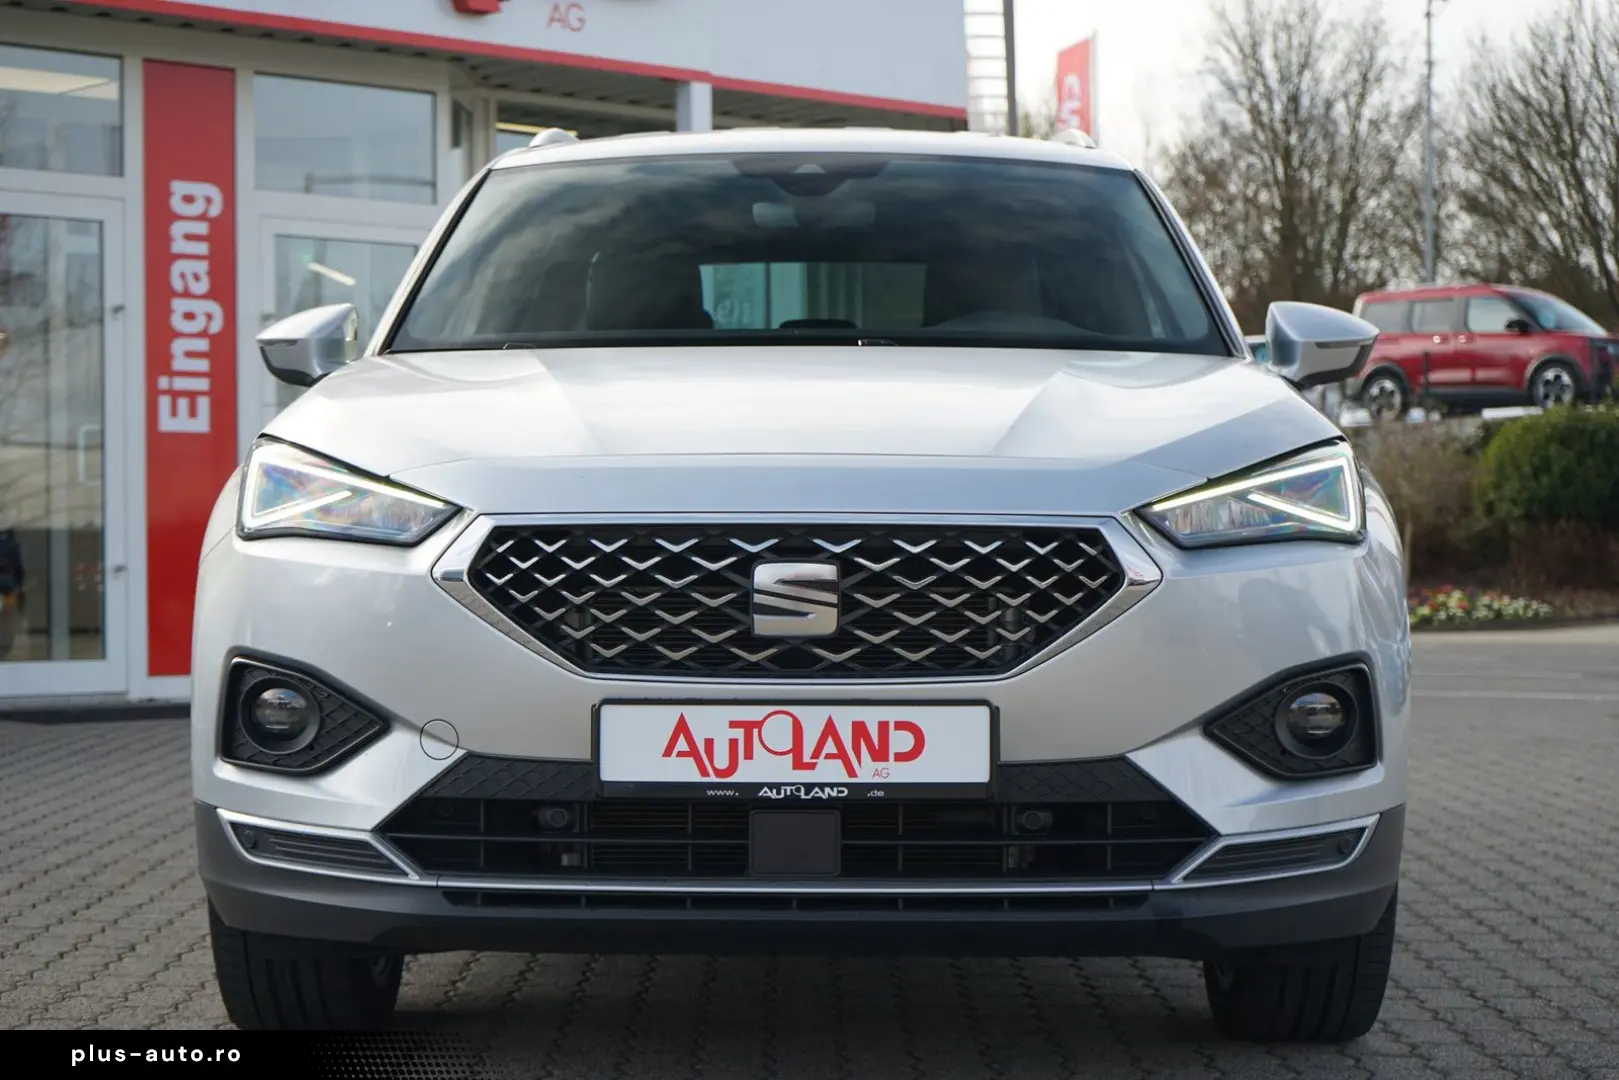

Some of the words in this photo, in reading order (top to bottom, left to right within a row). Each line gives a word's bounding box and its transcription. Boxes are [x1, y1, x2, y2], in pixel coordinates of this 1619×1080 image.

[547, 2, 586, 32] AG
[157, 179, 224, 434] Eingang
[662, 710, 926, 779] AUTOLAND
[872, 767, 890, 779] AG
[758, 784, 849, 799] AUTOLAND
[867, 788, 884, 797] .de
